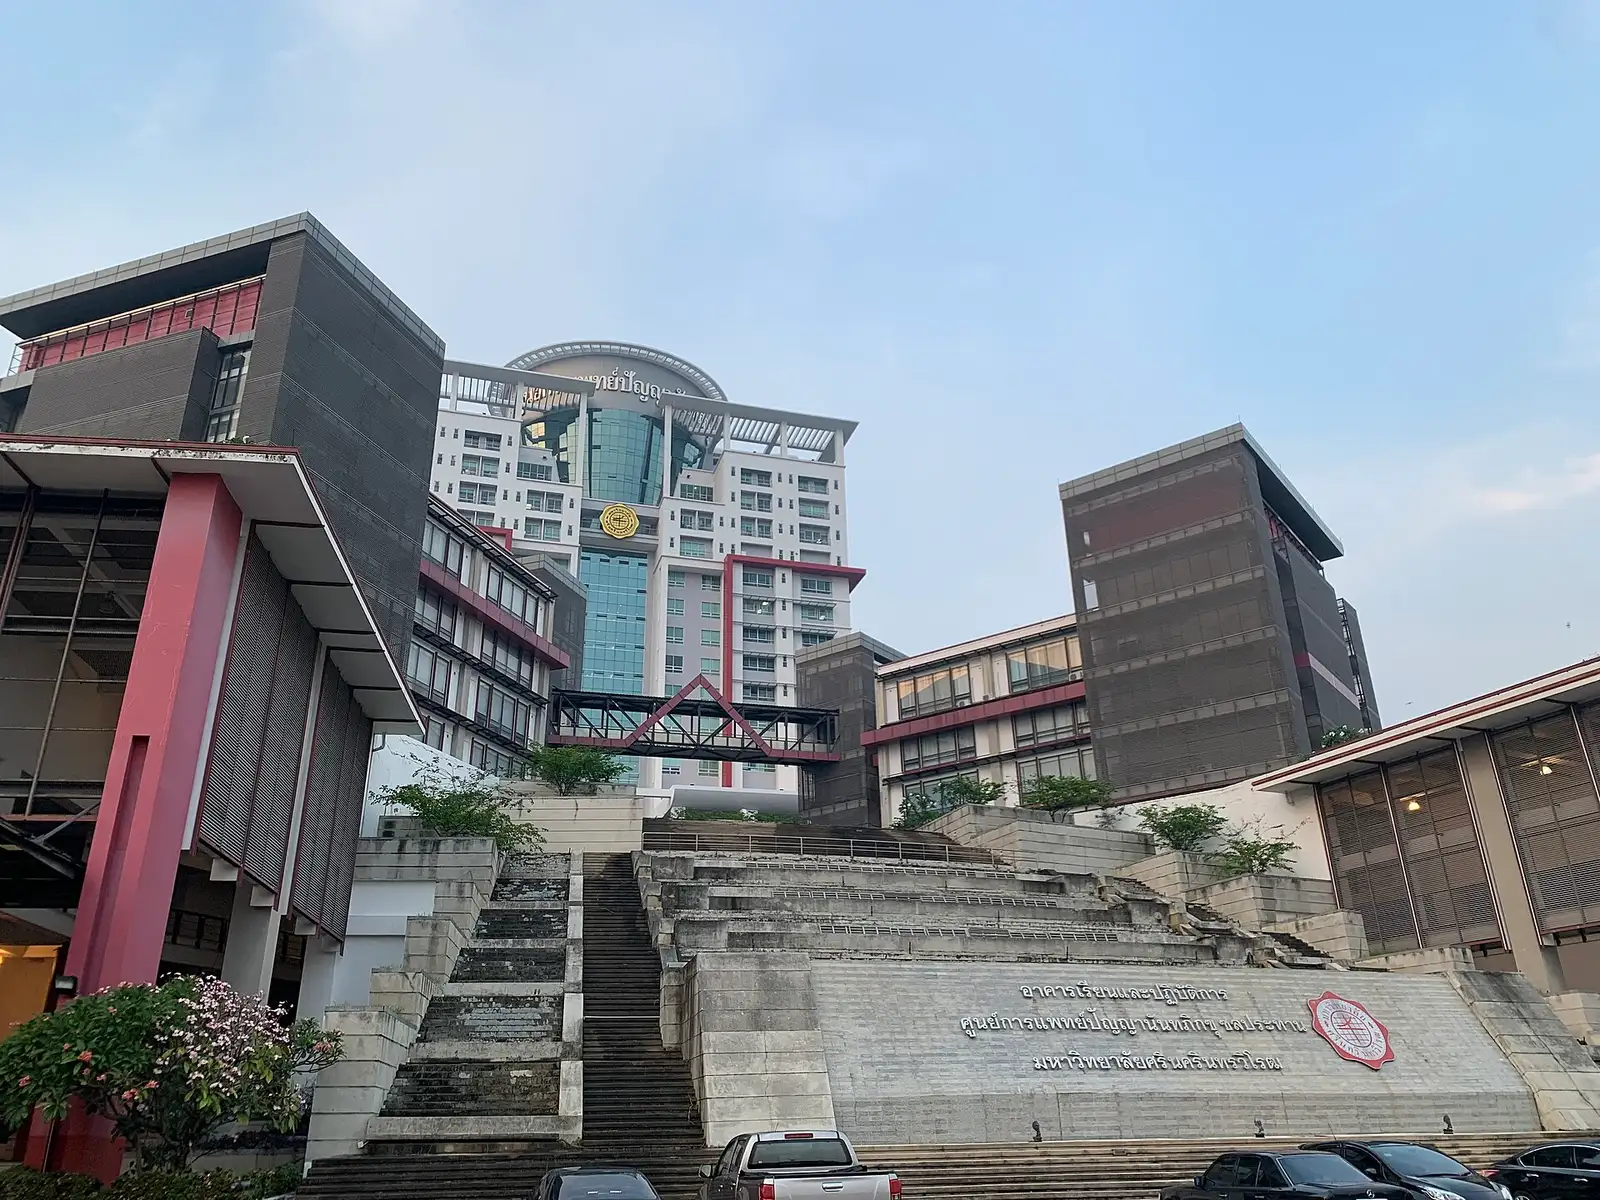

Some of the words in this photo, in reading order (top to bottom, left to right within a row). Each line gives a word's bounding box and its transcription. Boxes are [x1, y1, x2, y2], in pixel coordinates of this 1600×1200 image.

[1020, 980, 1229, 1005] อาคารเรียนและปฏิบัติการ
[1033, 1050, 1284, 1071] มหาวิทยาลัยศรีนครินทรวิโรฒ
